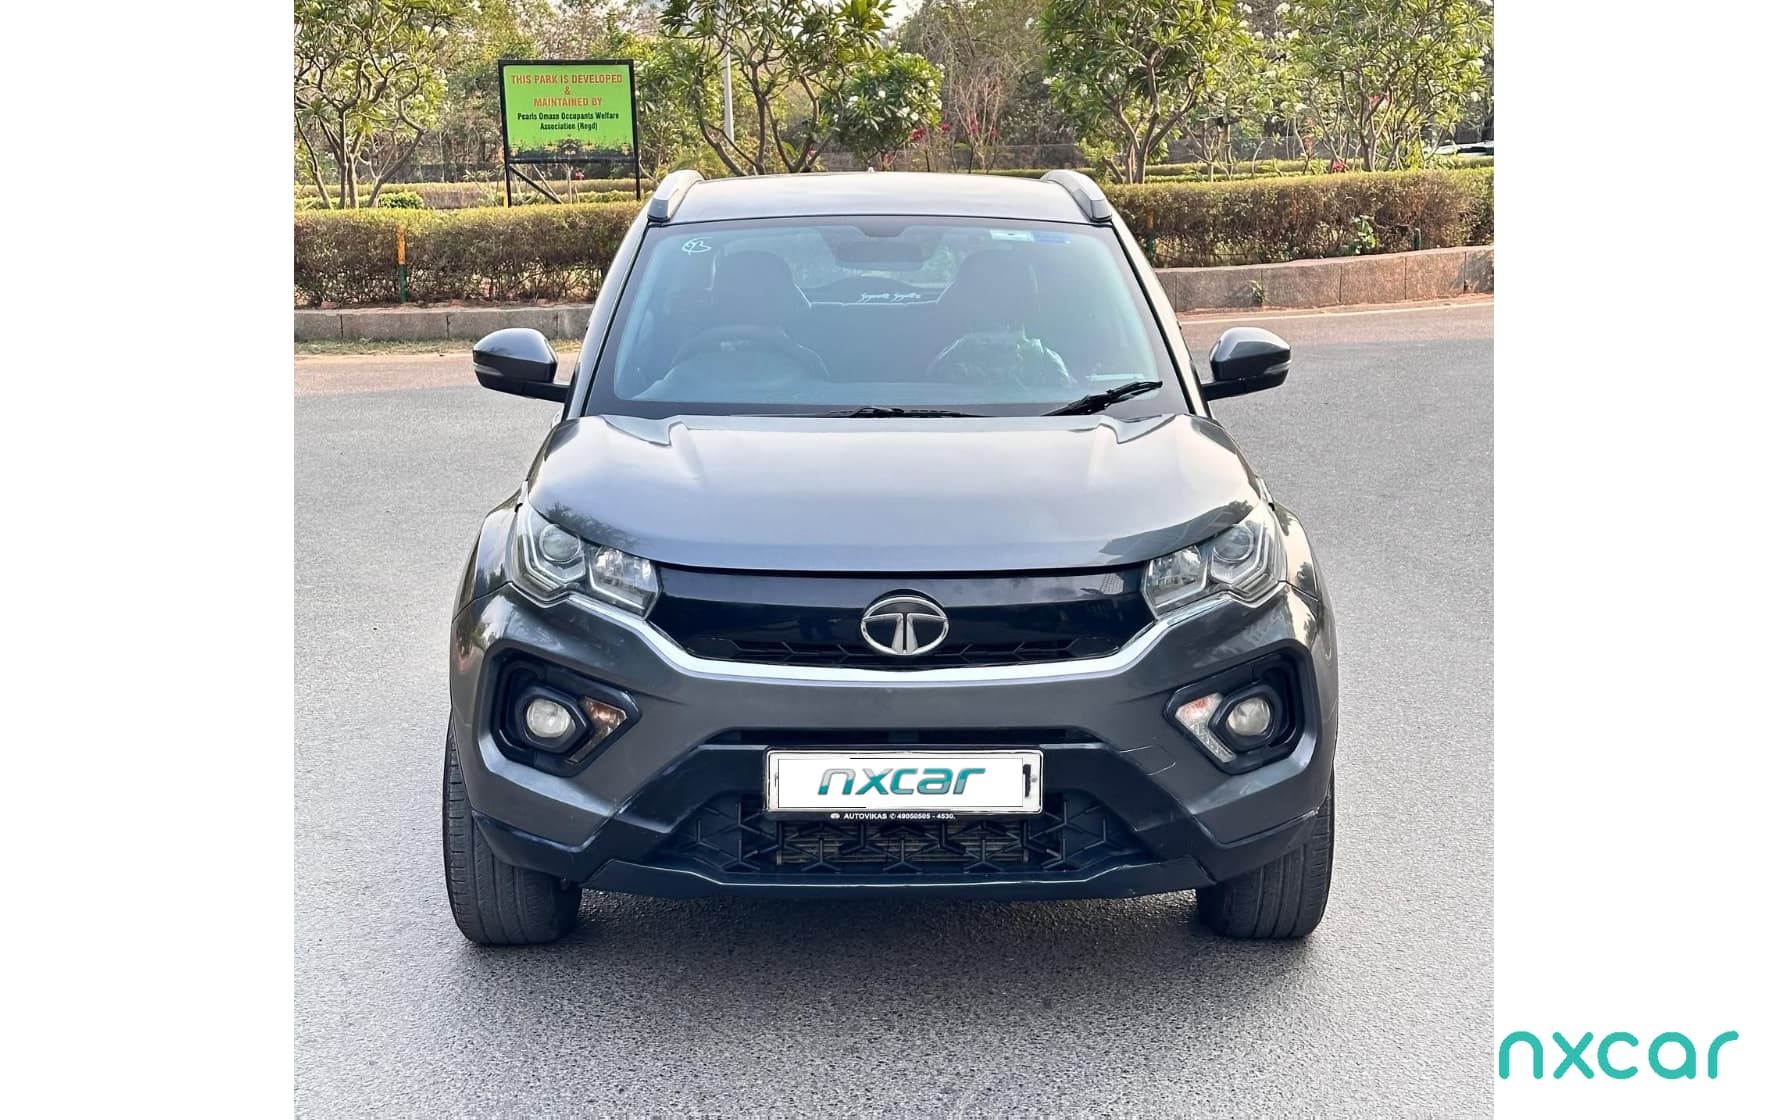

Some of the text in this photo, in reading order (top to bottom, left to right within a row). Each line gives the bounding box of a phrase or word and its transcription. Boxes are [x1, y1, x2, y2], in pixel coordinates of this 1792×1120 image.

[512, 74, 622, 84] THIS PARK IS DEVELOPED
[564, 85, 571, 95] &
[534, 97, 602, 106] MAINTAINED BY
[518, 112, 537, 120] Pearls
[562, 112, 593, 120] Occupants
[596, 112, 619, 120] Welfare
[540, 122, 576, 130] Association
[844, 812, 888, 820] AUTOVIKAS
